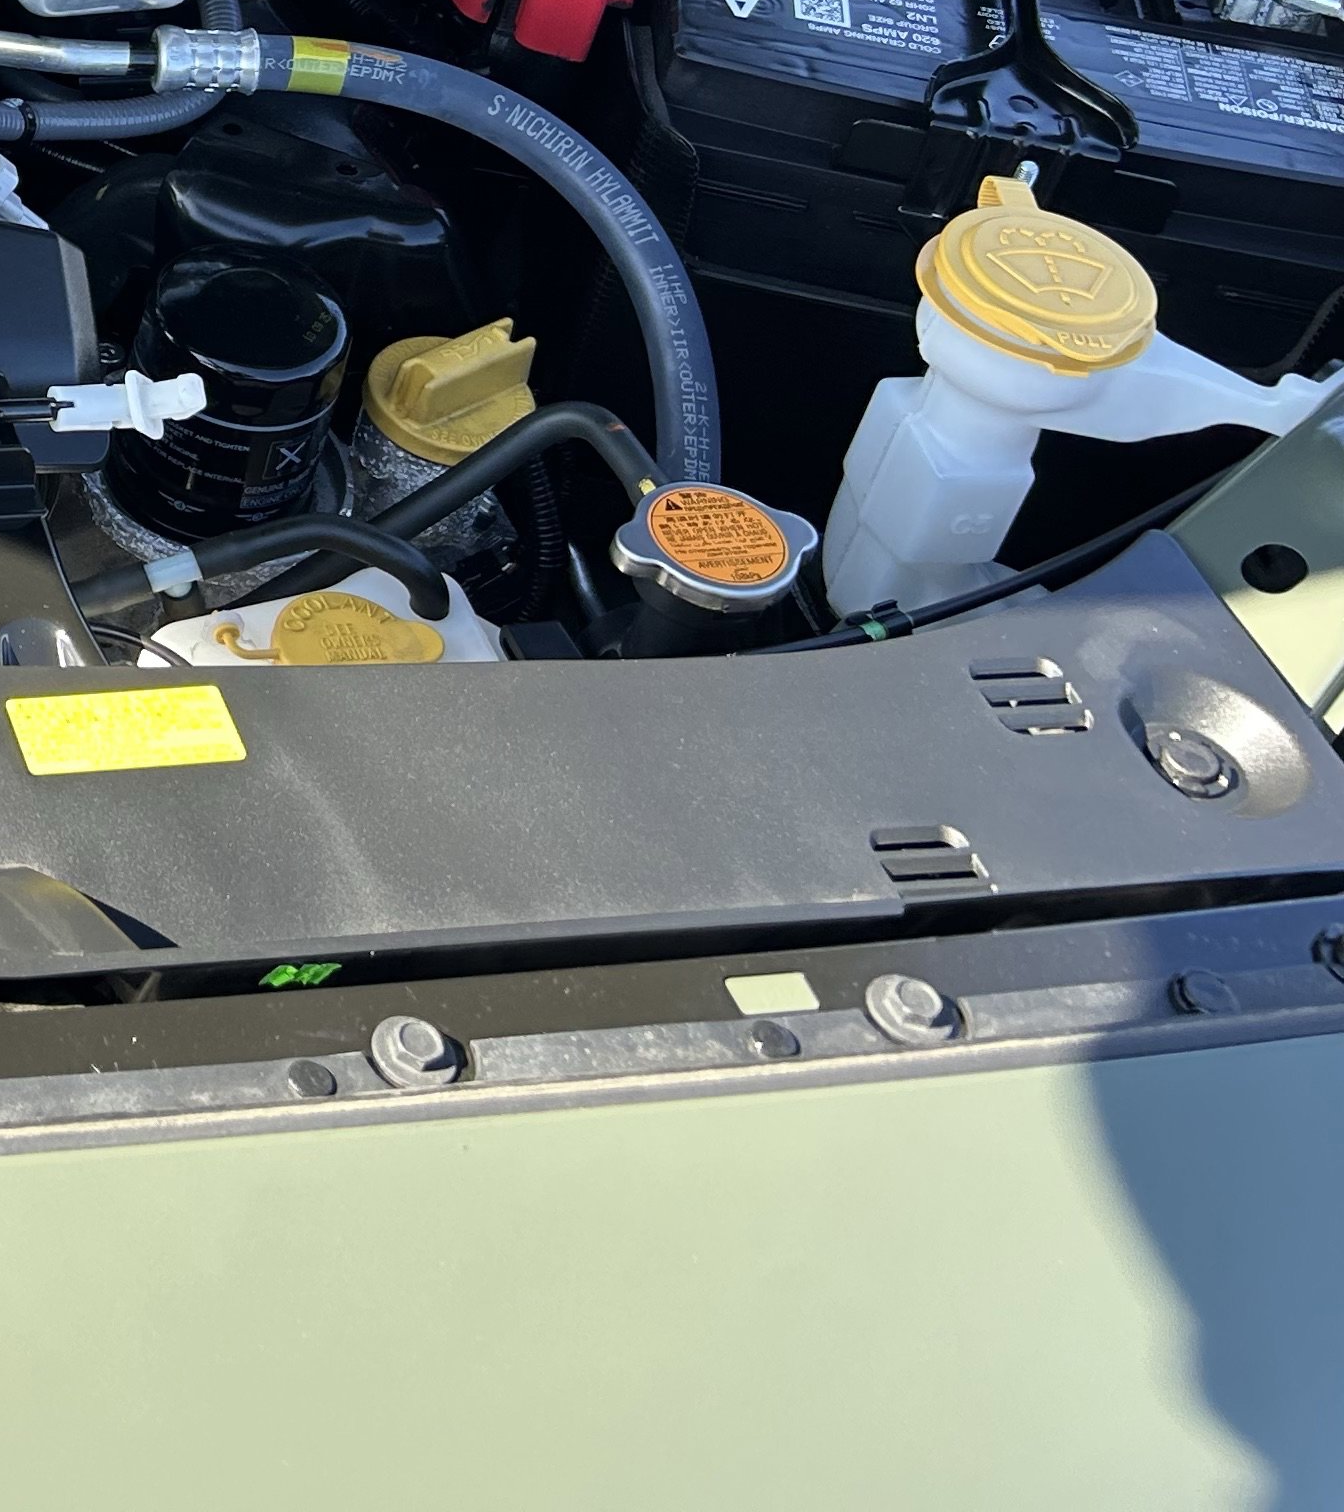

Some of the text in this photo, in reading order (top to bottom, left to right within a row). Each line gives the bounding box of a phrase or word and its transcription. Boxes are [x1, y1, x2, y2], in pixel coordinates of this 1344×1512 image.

[906, 11, 938, 25] LN2
[861, 23, 942, 46] 620 AMPS
[585, 167, 660, 245] HYLAMMIT
[1056, 331, 1112, 348] PULL
[284, 594, 396, 632] COOLANT
[325, 623, 353, 636] SEE
[325, 647, 388, 662] MANUAL
